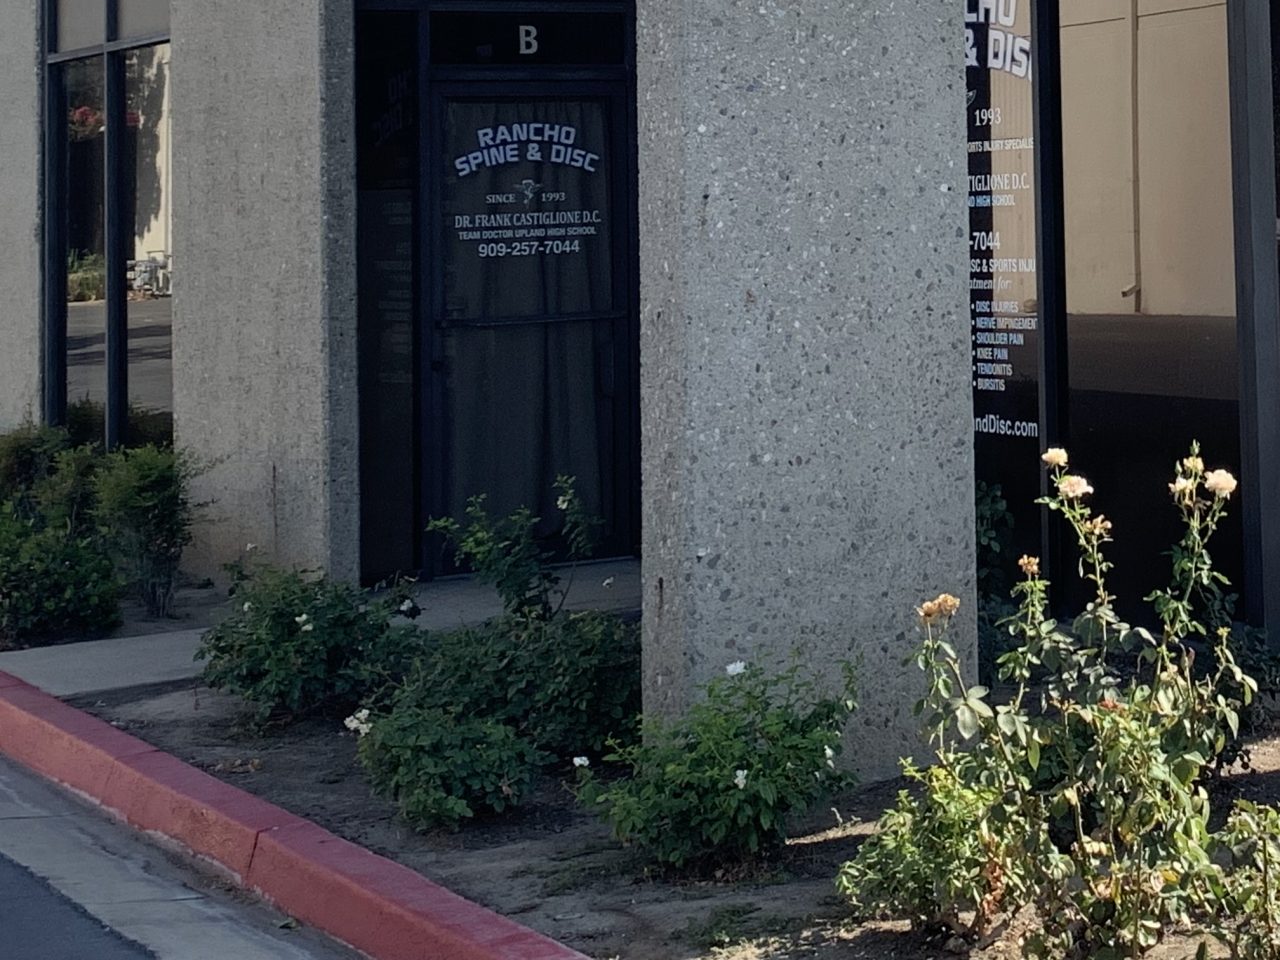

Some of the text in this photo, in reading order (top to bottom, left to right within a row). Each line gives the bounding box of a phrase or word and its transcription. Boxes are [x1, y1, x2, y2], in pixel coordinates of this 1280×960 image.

[519, 25, 538, 54] B
[988, 27, 1033, 82] DIS
[975, 108, 1001, 126] 1993
[477, 123, 576, 147] RANCHO
[454, 143, 600, 177] SPINE & DISC
[1012, 172, 1030, 190] D.C.
[486, 192, 566, 203] SINCE 1993
[976, 195, 991, 207] HIGH
[992, 194, 1015, 206] SCHOOL
[455, 210, 602, 228] DR. FRANK CASTIGLIONE D.C.
[458, 226, 597, 240] TEAM DOCTOR UPLAND HIGH SCHOOL
[478, 240, 580, 257] 909-257-7044
[989, 258, 1017, 272] SPORTS
[976, 301, 1018, 313] DISC INJURIES
[976, 317, 996, 329] NERVE
[977, 332, 1024, 345] SHOULDER PAIN
[977, 348, 1008, 360] KNEE PAIN
[977, 363, 1013, 376] TENDONITIS
[978, 378, 1005, 391] BURSITIS
[974, 414, 1038, 437] ndDisc.com
